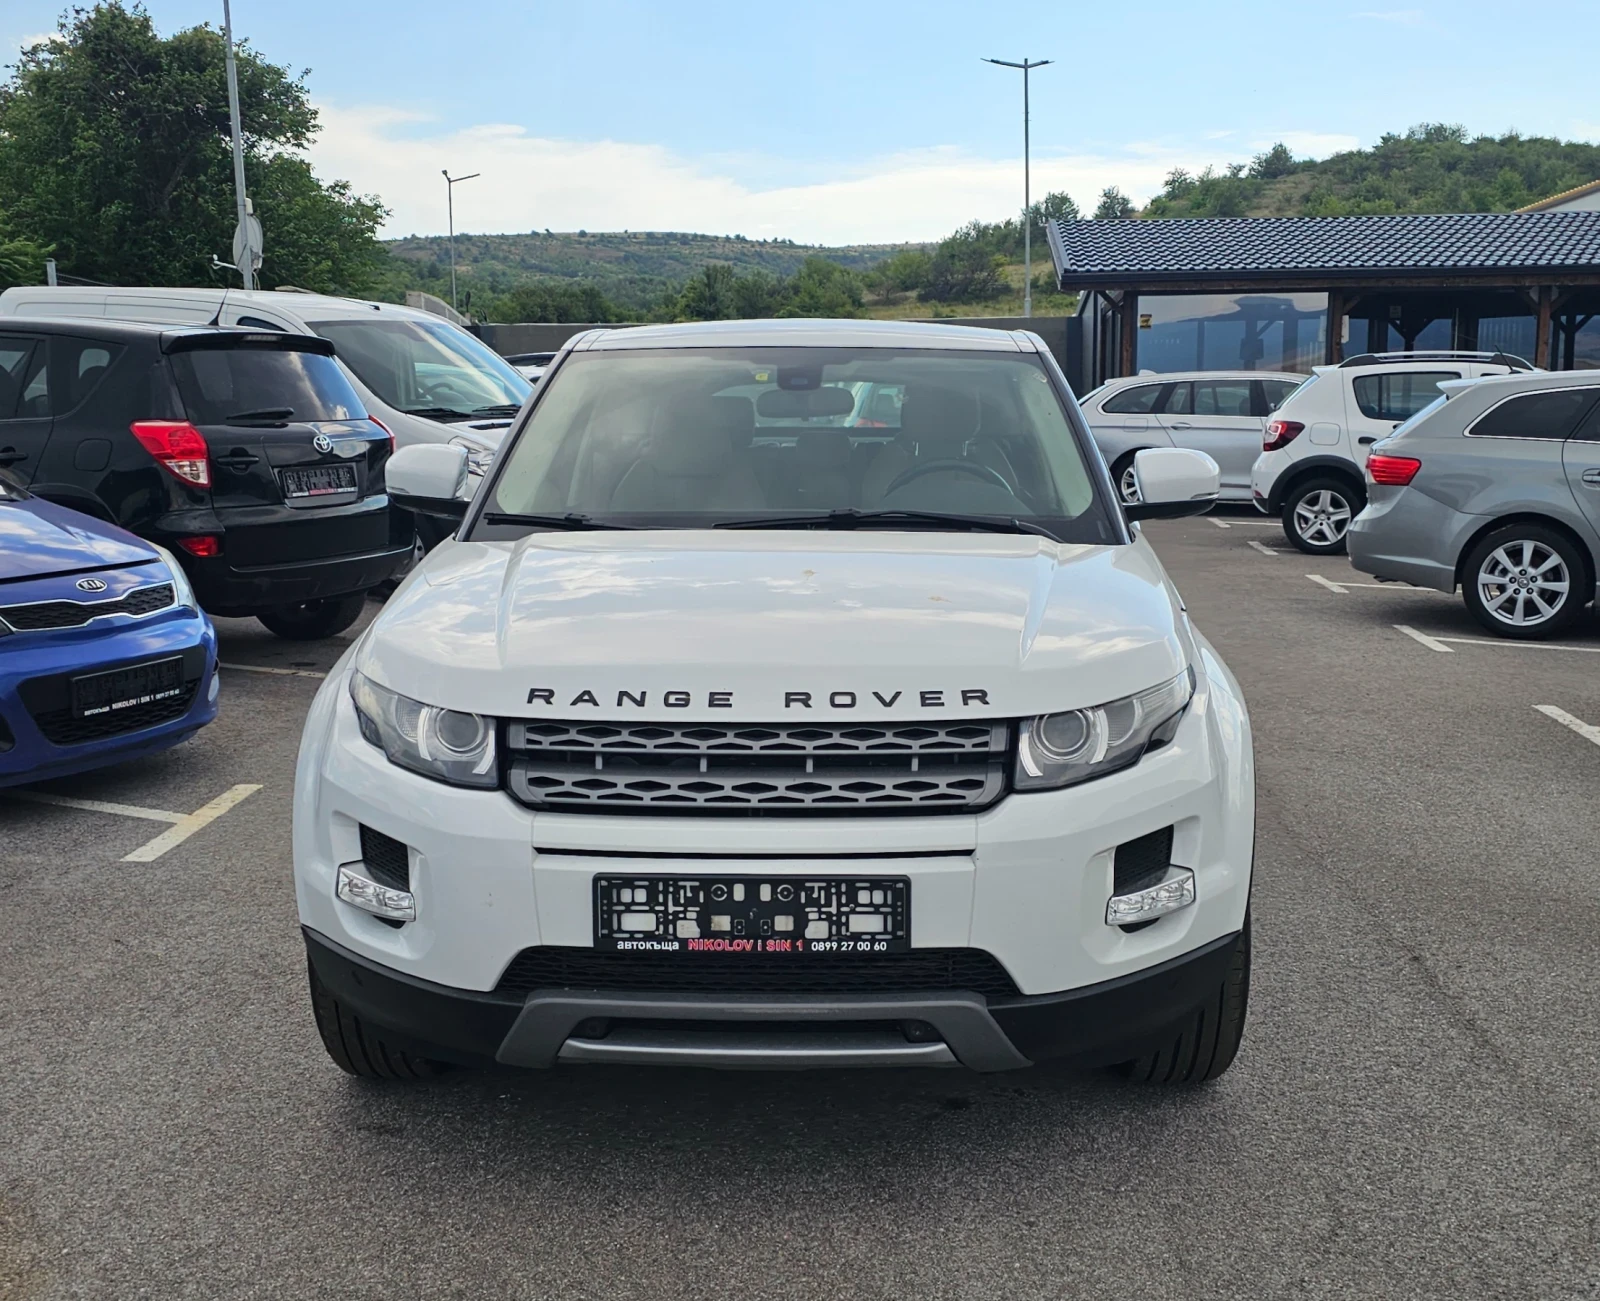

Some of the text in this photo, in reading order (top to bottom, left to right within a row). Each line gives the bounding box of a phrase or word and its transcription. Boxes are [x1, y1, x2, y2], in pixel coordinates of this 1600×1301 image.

[80, 580, 105, 589] KIA
[526, 687, 990, 708] RANGE ROVER
[617, 940, 680, 951] автокъща
[687, 939, 754, 951] NIKOLOV
[766, 939, 792, 951] SIN
[796, 939, 803, 951] 1
[811, 941, 838, 951] 0899
[841, 941, 855, 951] 27
[857, 941, 871, 951] 00
[873, 941, 887, 951] 60
